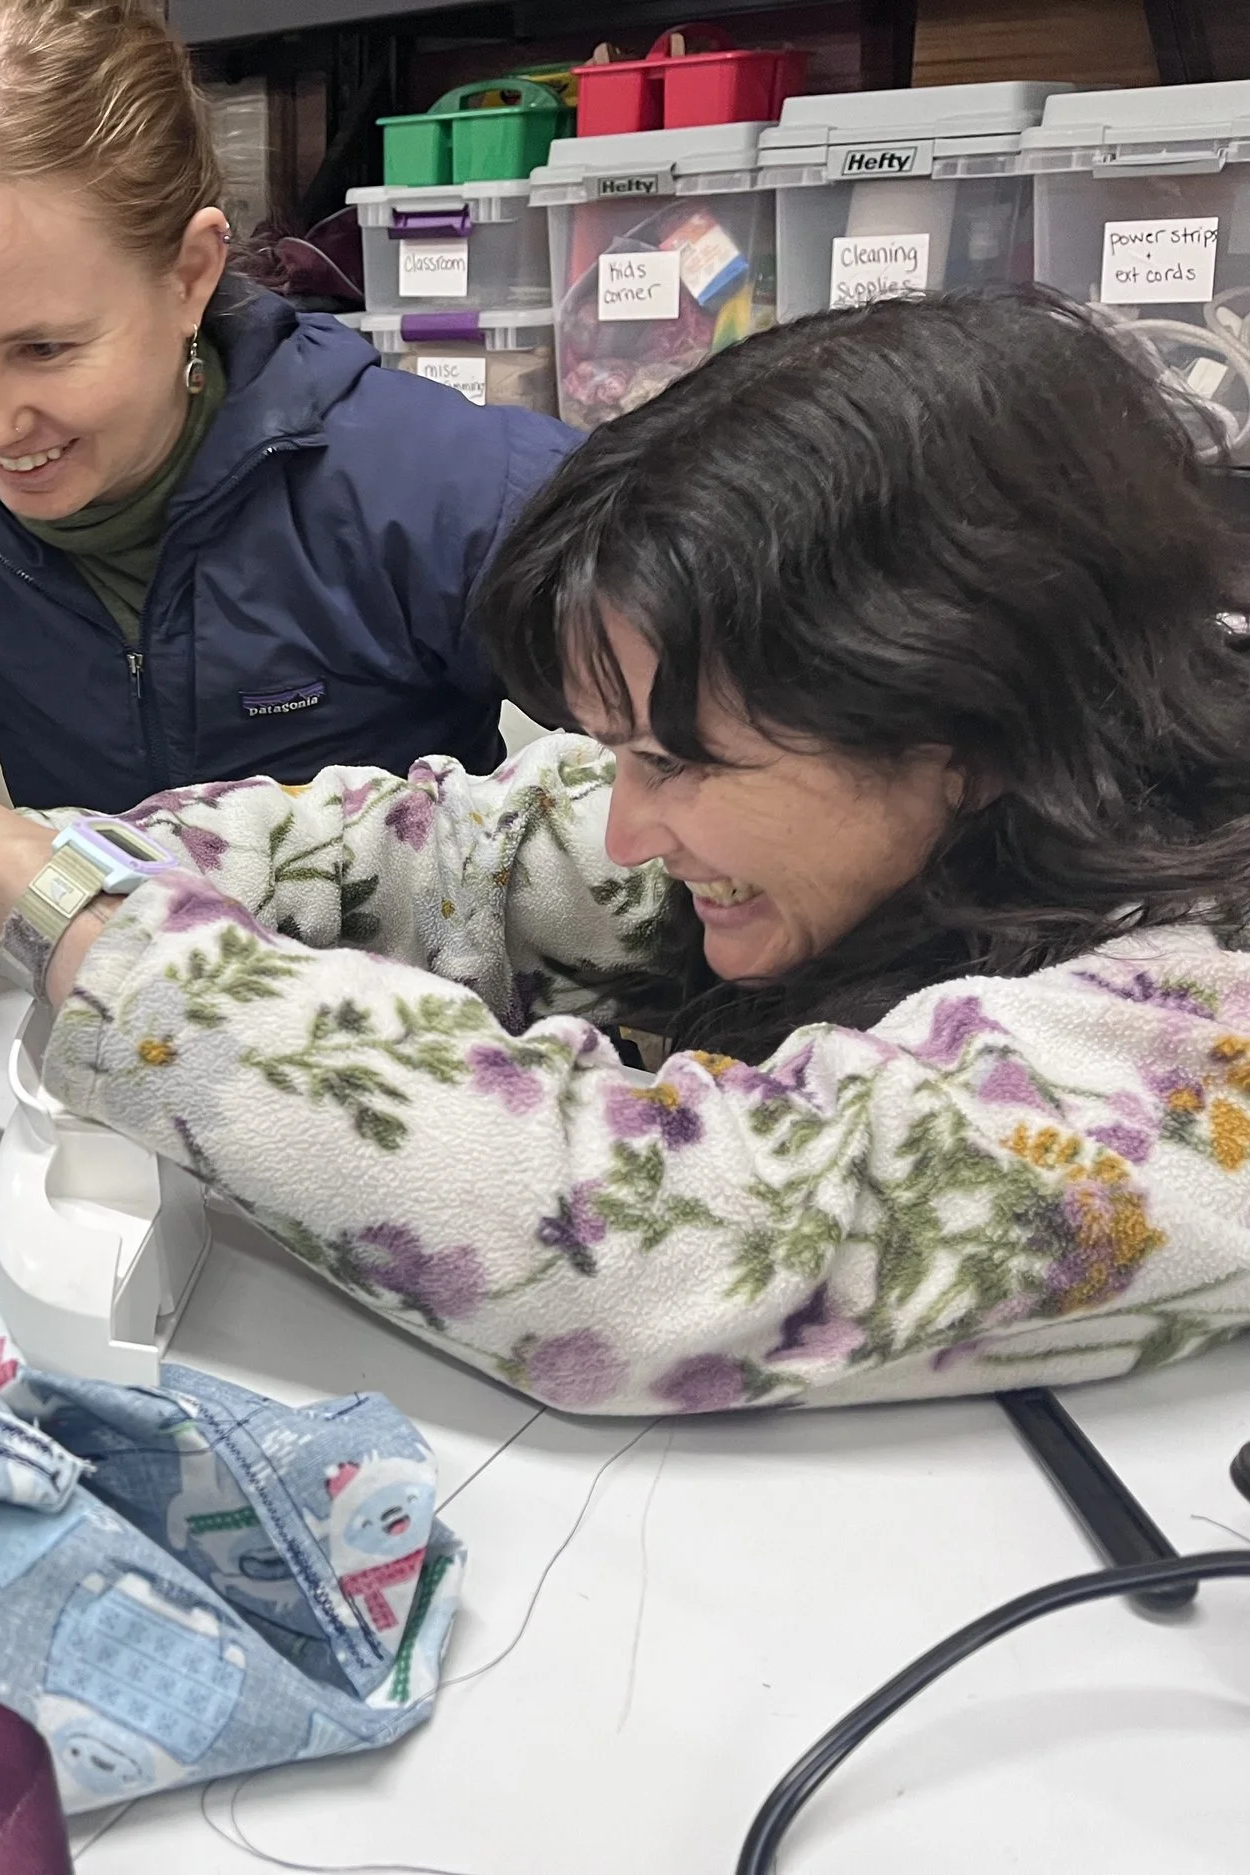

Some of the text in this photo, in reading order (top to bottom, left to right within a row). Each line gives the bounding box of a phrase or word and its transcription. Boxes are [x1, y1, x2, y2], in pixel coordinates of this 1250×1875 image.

[847, 151, 911, 172] Hefty
[602, 179, 654, 194] Hefty
[1110, 228, 1166, 256] power
[1115, 262, 1196, 284] ext cords
[604, 283, 662, 304] corner
[249, 695, 319, 717] patagonia
